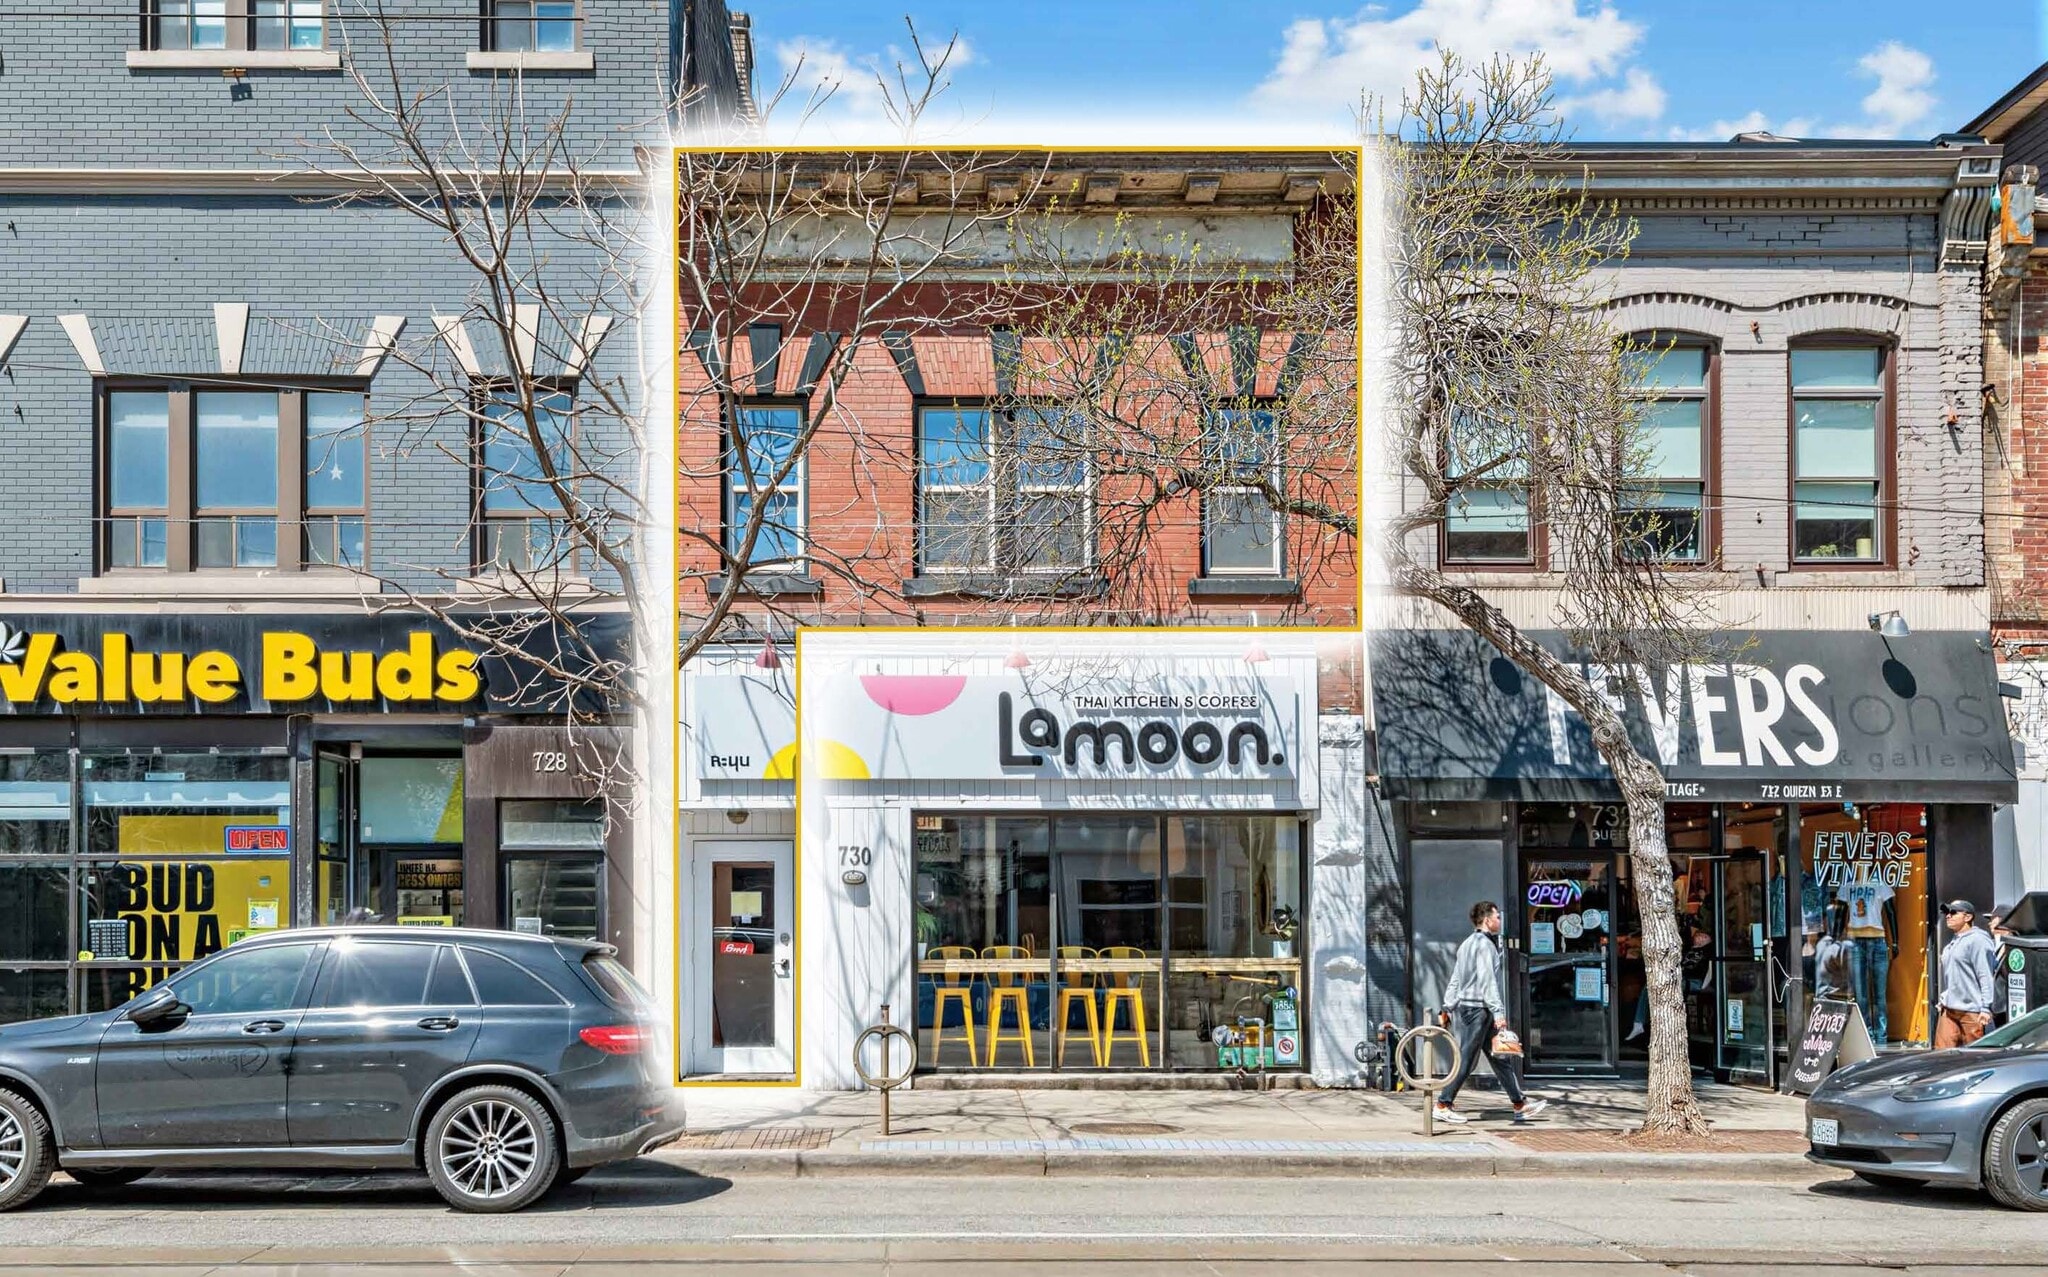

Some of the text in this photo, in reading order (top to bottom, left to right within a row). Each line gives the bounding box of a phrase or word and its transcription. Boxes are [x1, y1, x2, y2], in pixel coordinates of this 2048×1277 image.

[0, 631, 480, 703] Value Buds
[1074, 696, 1108, 708] THAI
[1113, 696, 1179, 708] KITCHEN
[532, 751, 568, 772] 728
[1868, 742, 1998, 773] gallery
[229, 829, 288, 849] OPEN
[1813, 831, 1912, 859] FEVERS
[838, 846, 872, 866] 730
[1813, 860, 1913, 887] VINTAGE
[118, 863, 215, 913] BUD
[1527, 883, 1574, 906] OPEN
[193, 914, 223, 957] A
